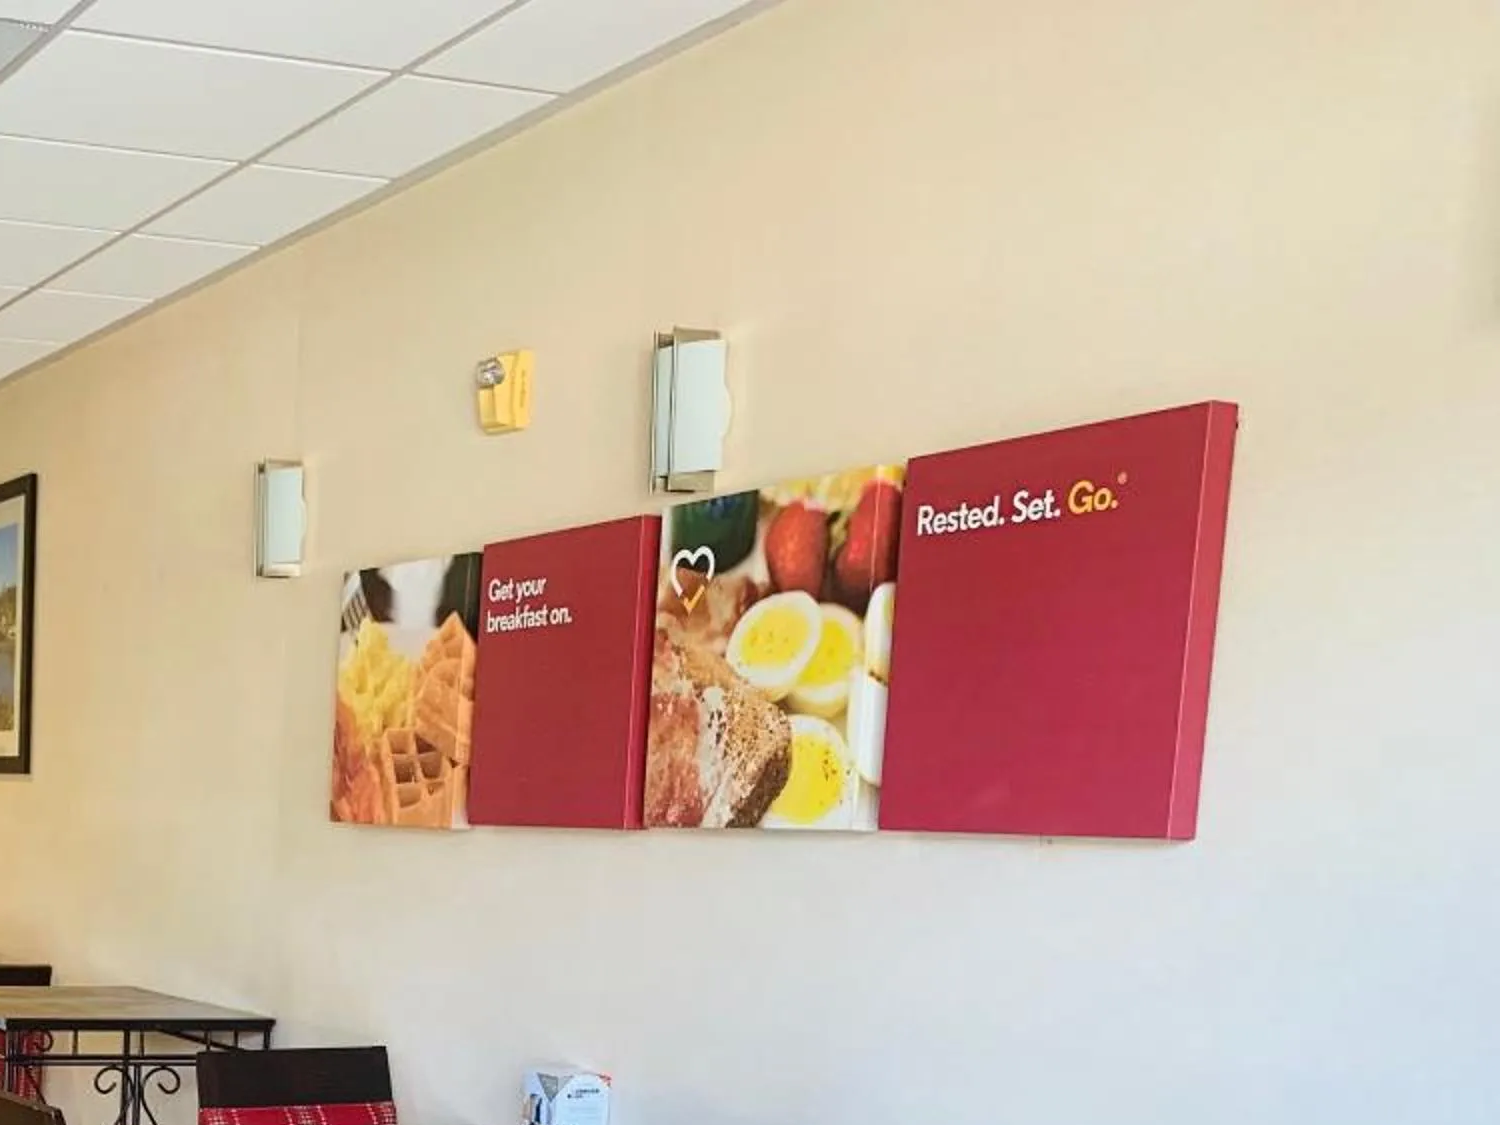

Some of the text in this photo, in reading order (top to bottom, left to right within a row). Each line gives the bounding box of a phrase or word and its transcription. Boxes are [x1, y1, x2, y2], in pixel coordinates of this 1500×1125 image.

[917, 495, 1005, 536] Rested.
[1011, 489, 1061, 523] Set.
[488, 578, 546, 604] Get your
[487, 604, 573, 633] breakfast on.
